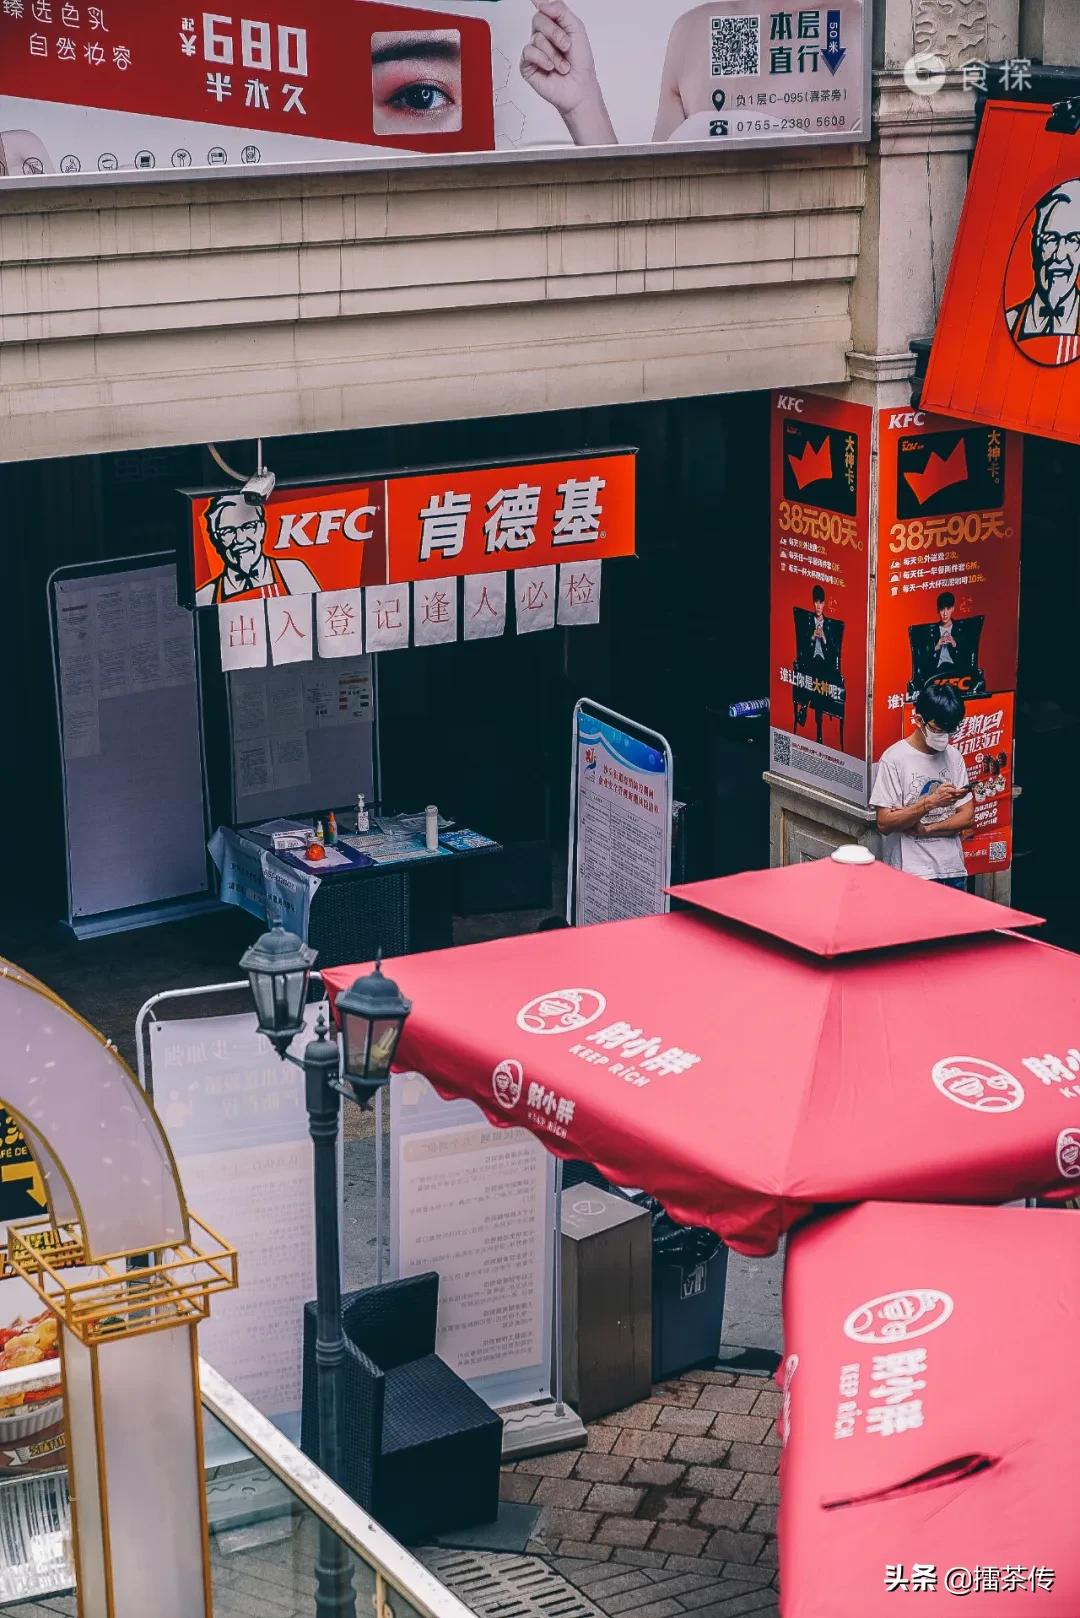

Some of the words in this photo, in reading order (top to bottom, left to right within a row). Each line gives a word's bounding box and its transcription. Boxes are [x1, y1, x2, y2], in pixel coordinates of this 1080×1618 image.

[3, 0, 110, 32] 臻选色乳
[181, 17, 195, 32] 起
[769, 11, 820, 40] 本层
[29, 32, 132, 70] 自然妆容
[769, 45, 820, 74] 直行
[206, 72, 307, 115] 半永久
[776, 394, 804, 413] KFC
[888, 412, 926, 430] KFC
[273, 505, 377, 550] KFC
[419, 475, 606, 562] 肯德基
[228, 572, 596, 650] 出入登记逢人必检
[568, 1044, 609, 1065] KEEP
